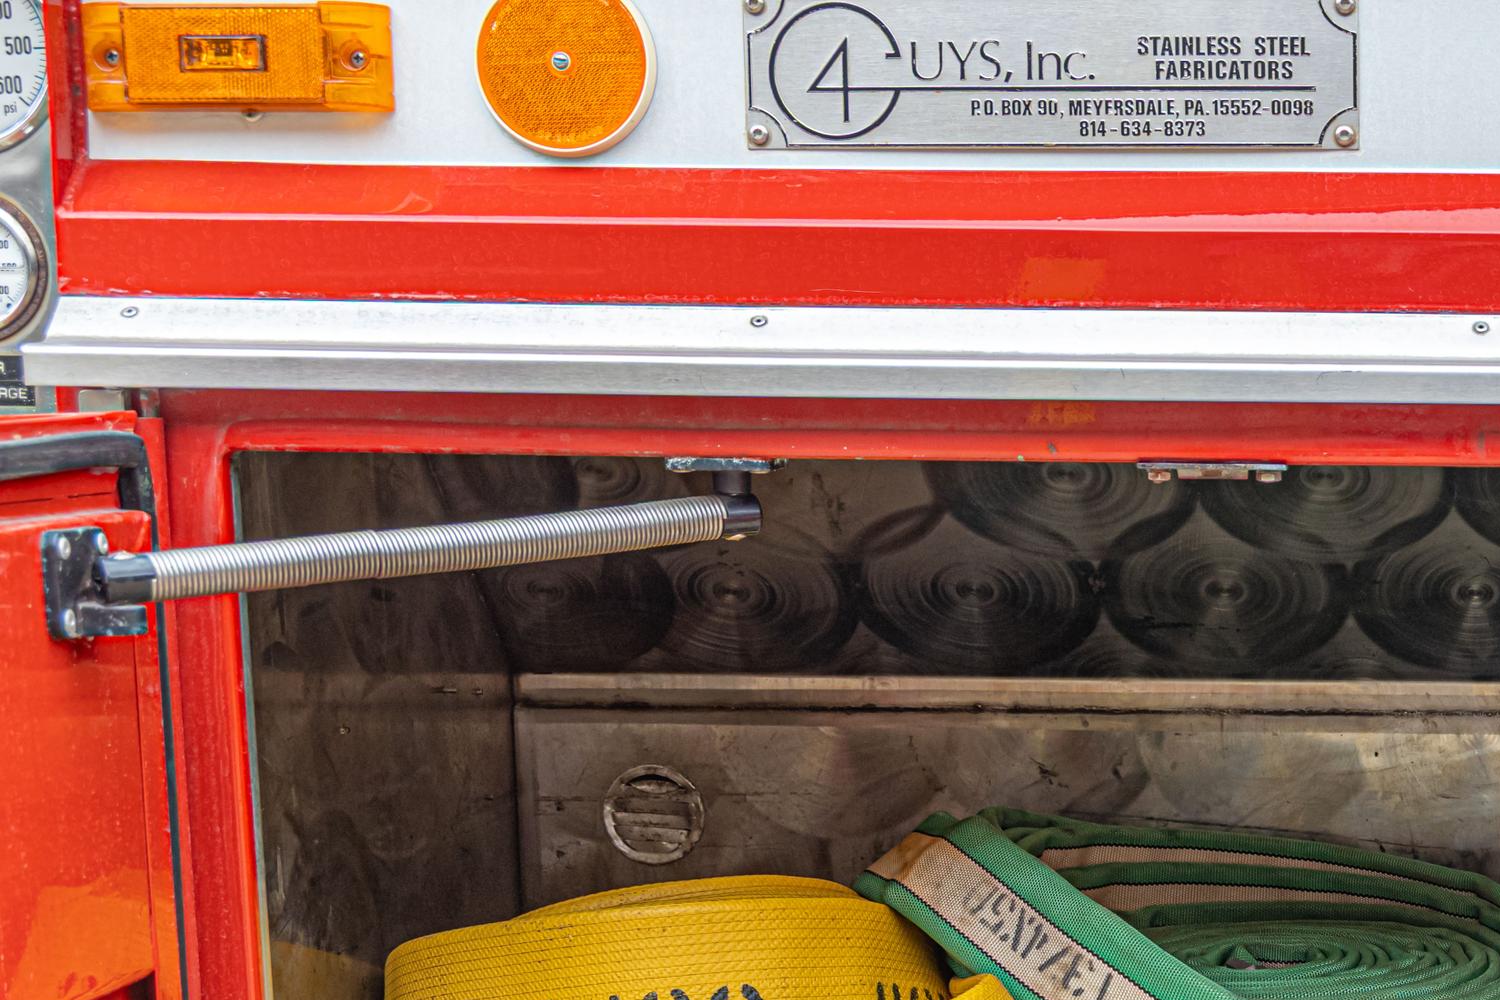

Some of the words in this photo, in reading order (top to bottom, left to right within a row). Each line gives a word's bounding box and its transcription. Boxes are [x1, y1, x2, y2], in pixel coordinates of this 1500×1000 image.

[4, 36, 32, 55] 500
[1137, 36, 1242, 56] STAINLESS
[1254, 36, 1311, 56] STEEL
[1026, 40, 1096, 81] Inc.
[1155, 60, 1293, 80] FABRICATORS
[4, 102, 17, 115] psi
[1002, 100, 1032, 115] BOX
[1037, 100, 1064, 118] 90,
[1079, 121, 1206, 137] 814-634-8373
